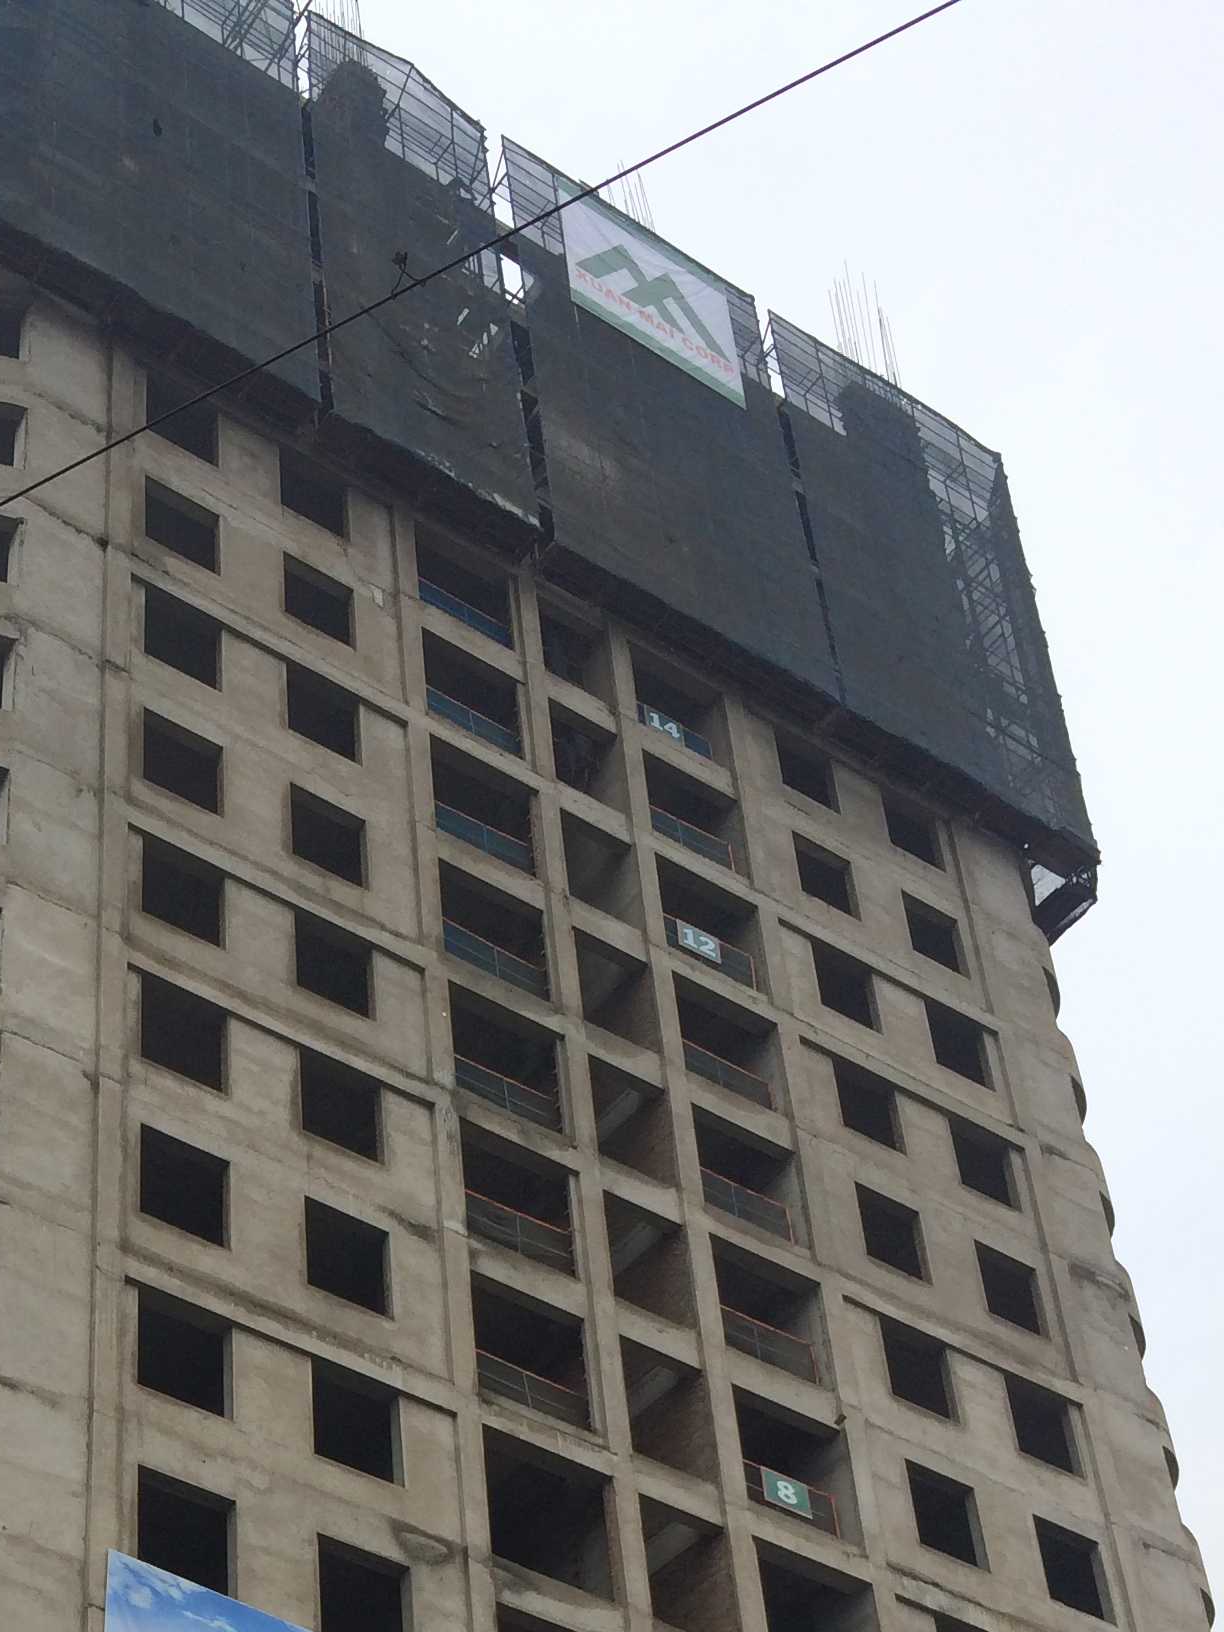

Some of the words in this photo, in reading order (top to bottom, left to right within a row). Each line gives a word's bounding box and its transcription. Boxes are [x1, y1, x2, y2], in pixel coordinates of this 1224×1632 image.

[649, 713, 680, 738] 14
[683, 928, 716, 957] 12
[776, 1480, 798, 1504] 8
